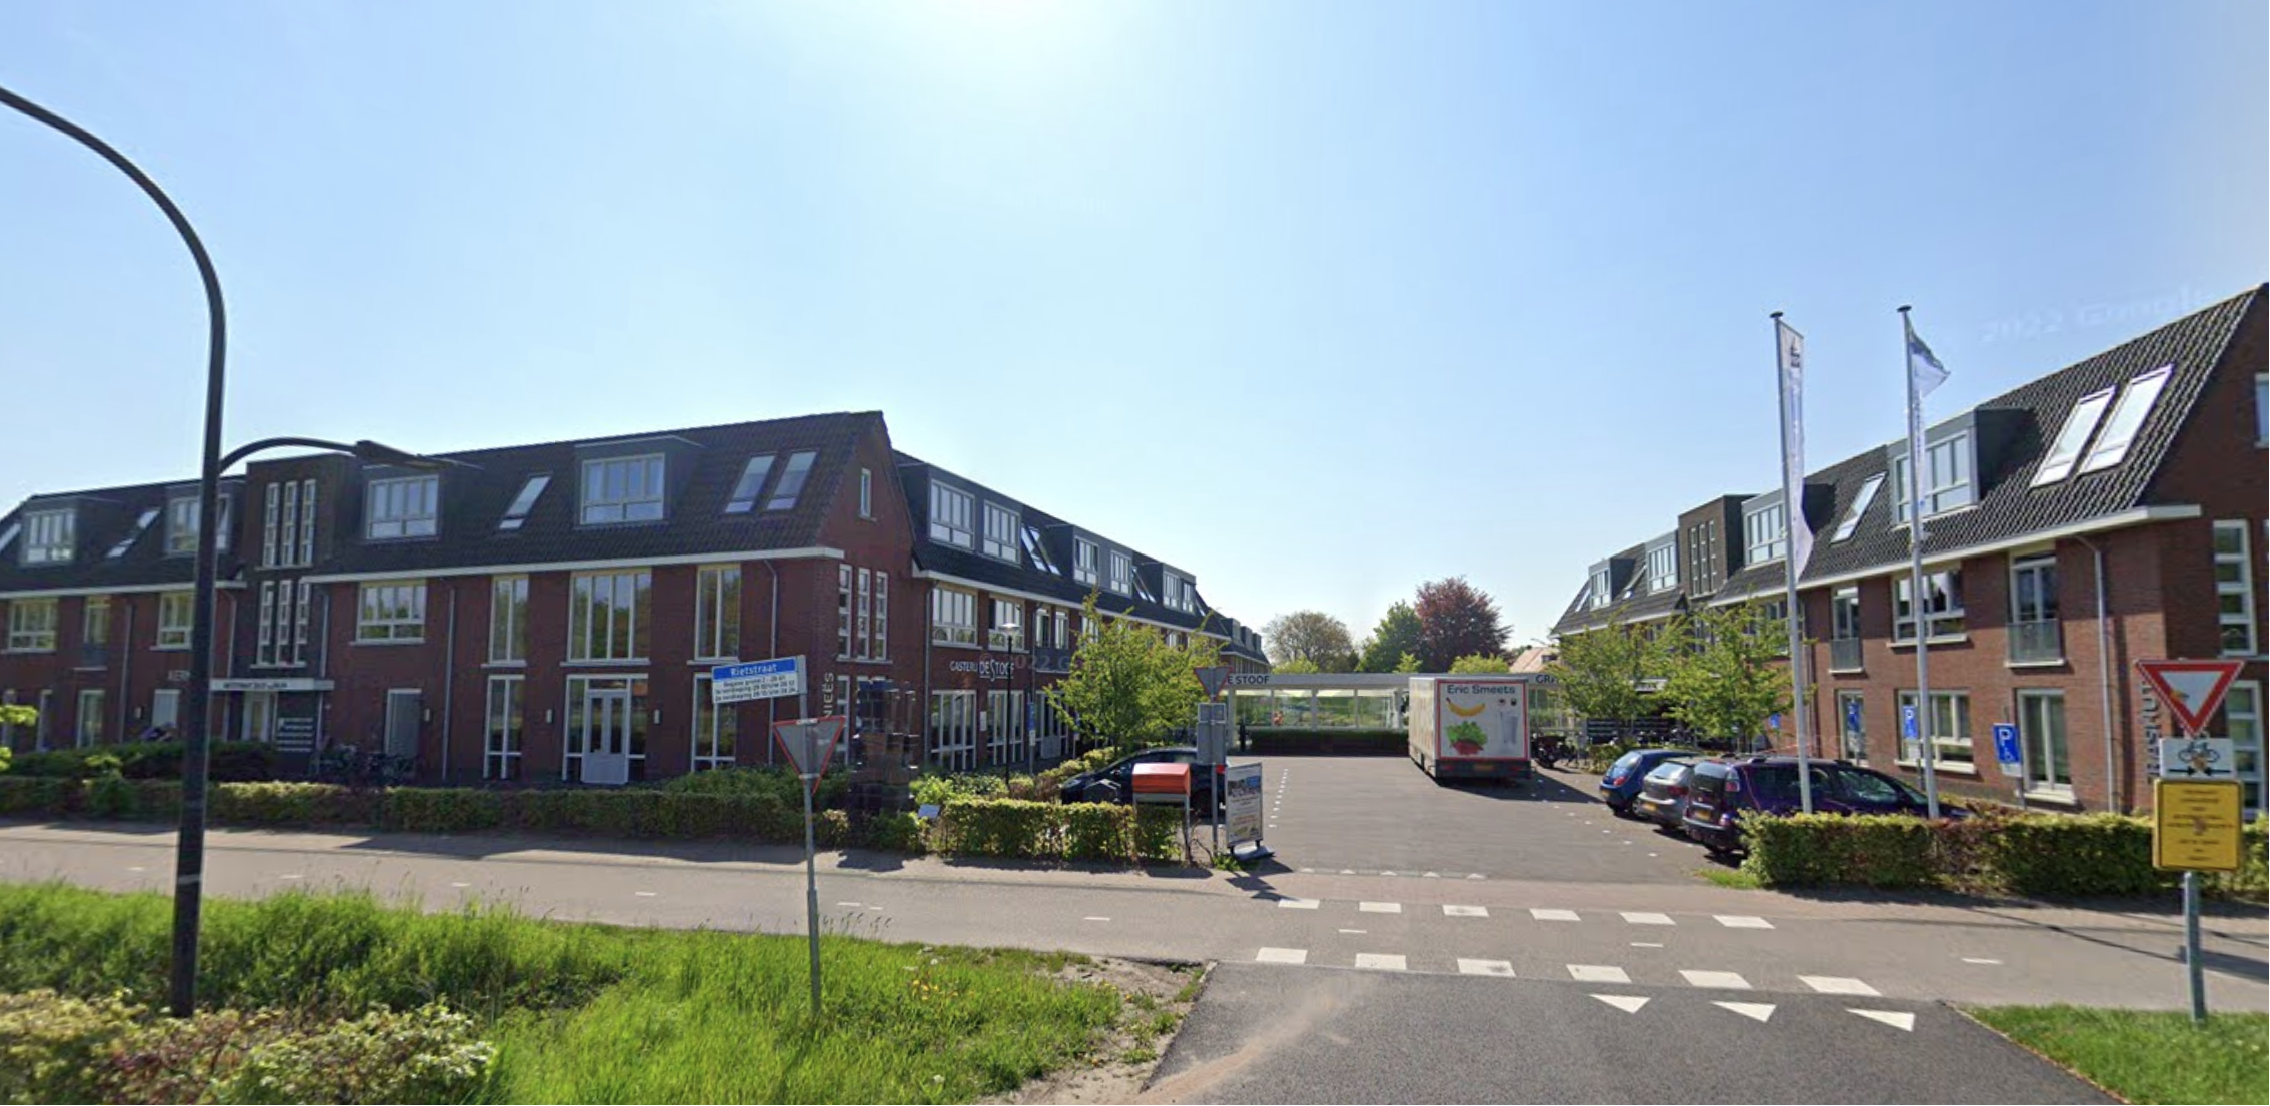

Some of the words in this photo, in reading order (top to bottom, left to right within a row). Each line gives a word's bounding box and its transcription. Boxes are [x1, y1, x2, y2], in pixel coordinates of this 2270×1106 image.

[730, 663, 777, 677] Rietstraat
[1235, 675, 1270, 684] STOOF
[1447, 684, 1469, 694] Eric
[1472, 684, 1515, 695] Smeets
[1905, 709, 1914, 724] P
[1999, 728, 2012, 746] P
